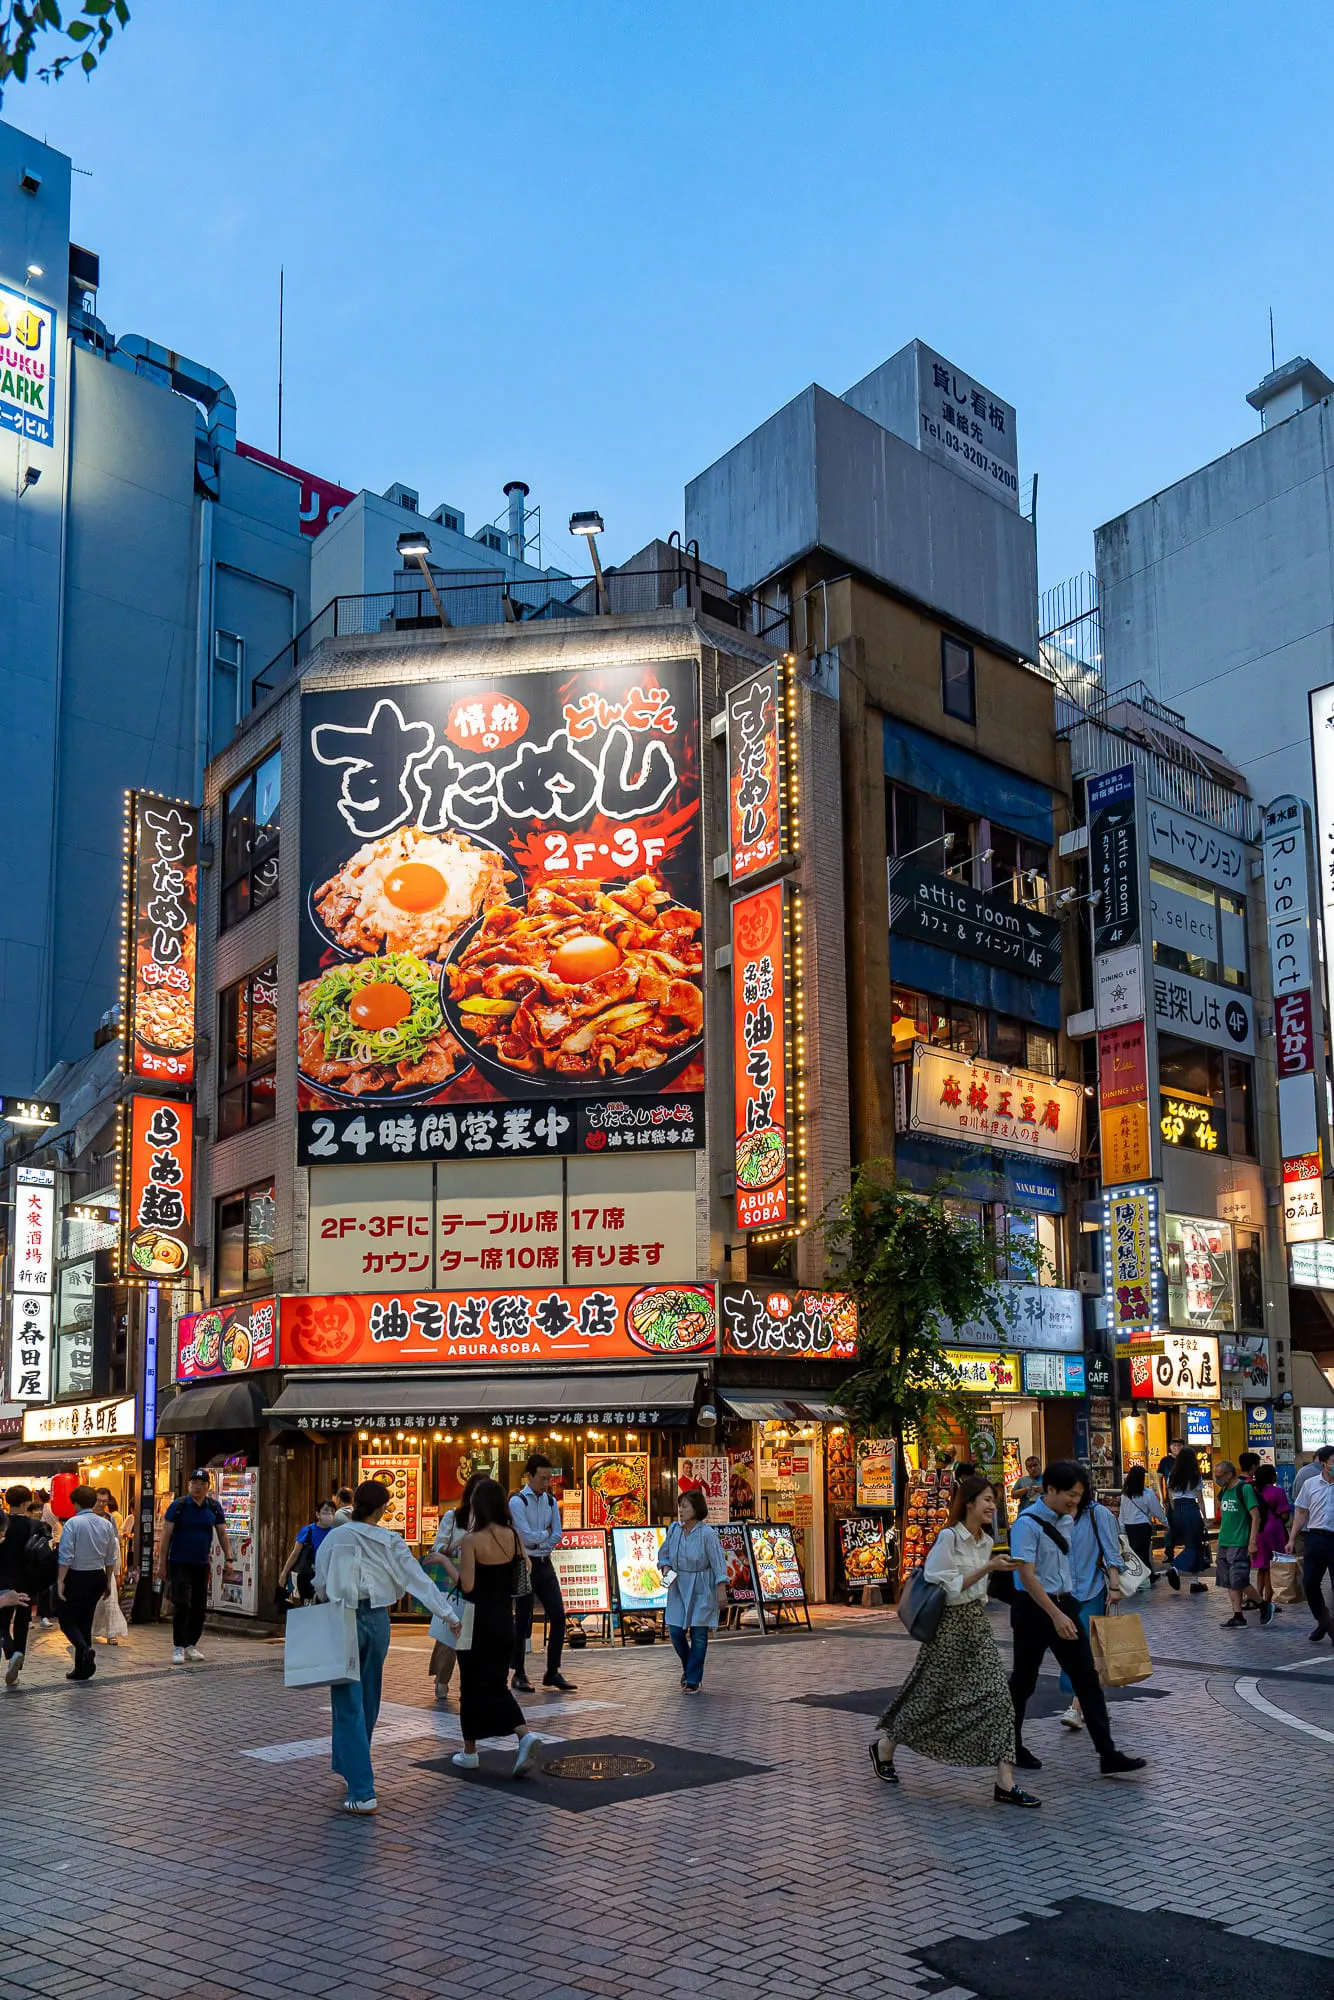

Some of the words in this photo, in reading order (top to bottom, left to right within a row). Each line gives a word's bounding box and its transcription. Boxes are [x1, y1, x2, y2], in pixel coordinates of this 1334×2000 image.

[0, 369, 45, 411] ARK
[932, 363, 1005, 434] 貸し看板
[0, 406, 49, 440] ークビル
[942, 400, 983, 444] 連絡先
[563, 687, 678, 742] どんどん
[311, 698, 678, 838] すためし
[732, 682, 771, 846] すためし
[1118, 829, 1128, 869] attic
[145, 809, 193, 965] すためし
[919, 883, 966, 913] attic
[975, 903, 1020, 932] room
[1119, 876, 1129, 916] room
[920, 910, 948, 932] カフェ
[957, 924, 967, 940] &
[975, 931, 1021, 957] ダイニング
[1271, 836, 1302, 988] R.select
[1110, 929, 1123, 942] 4F
[142, 963, 190, 992] どんどん
[759, 956, 773, 999] 東京
[1027, 948, 1042, 968] 4F
[1101, 971, 1124, 984] DINING
[1126, 967, 1138, 976] LEE
[743, 962, 758, 1005] 名物
[1280, 996, 1307, 1072] とんかつ
[744, 1003, 775, 1135] 油そば
[1102, 1086, 1129, 1100] DINING
[1131, 1082, 1145, 1093] LEE
[307, 1106, 570, 1157] 24時間営業中
[608, 1128, 695, 1146] 油そば総本店
[739, 1190, 785, 1212] ABURA
[743, 1206, 780, 1225] SOBA
[26, 1194, 42, 1264] 大衆酒場
[370, 1291, 618, 1343] 油そば総本店
[724, 1289, 834, 1352] すためし
[17, 1321, 46, 1395] 春田屋
[447, 1342, 541, 1356] ABURASOBA
[1156, 1351, 1217, 1389] 日高屋
[1088, 1372, 1109, 1383] CAFE
[710, 1459, 723, 1498] 大募集
